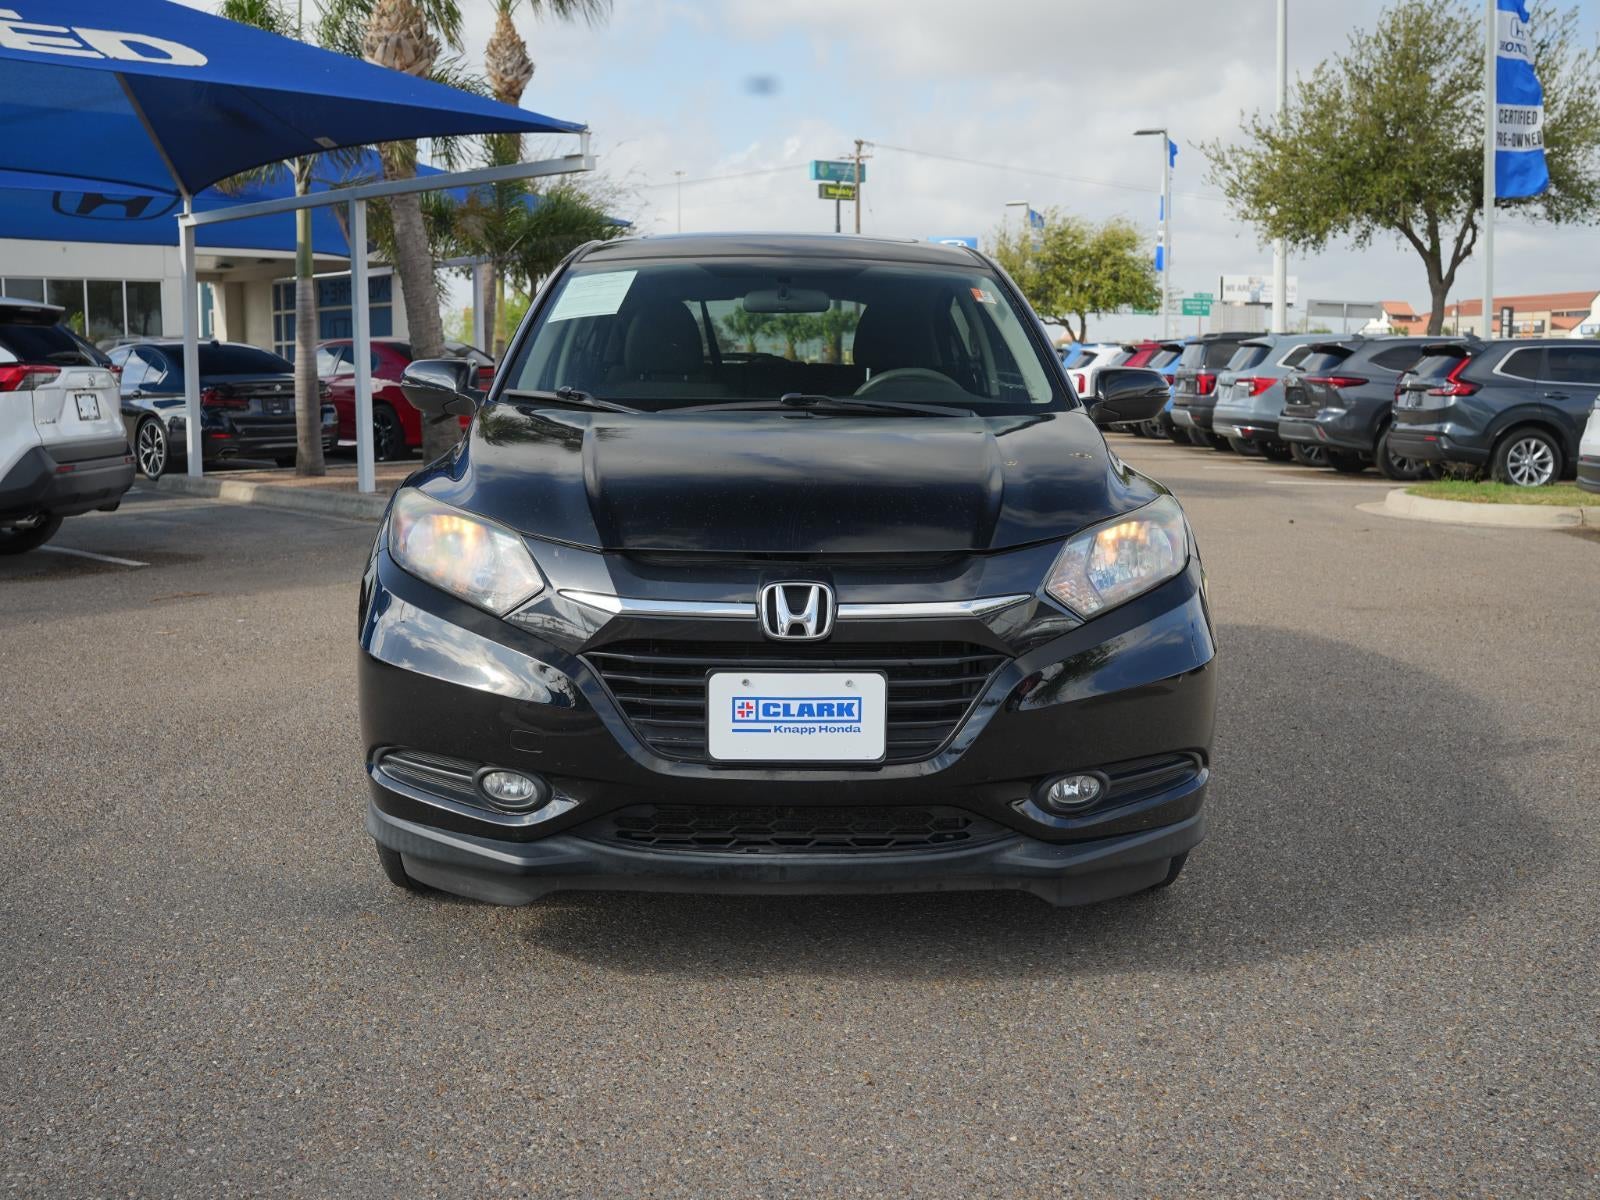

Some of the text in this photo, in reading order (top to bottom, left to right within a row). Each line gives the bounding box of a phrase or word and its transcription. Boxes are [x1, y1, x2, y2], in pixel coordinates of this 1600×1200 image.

[1498, 109, 1538, 125] CERTIFIED
[762, 702, 856, 718] CLARK
[773, 724, 861, 735] Knapp Honda
